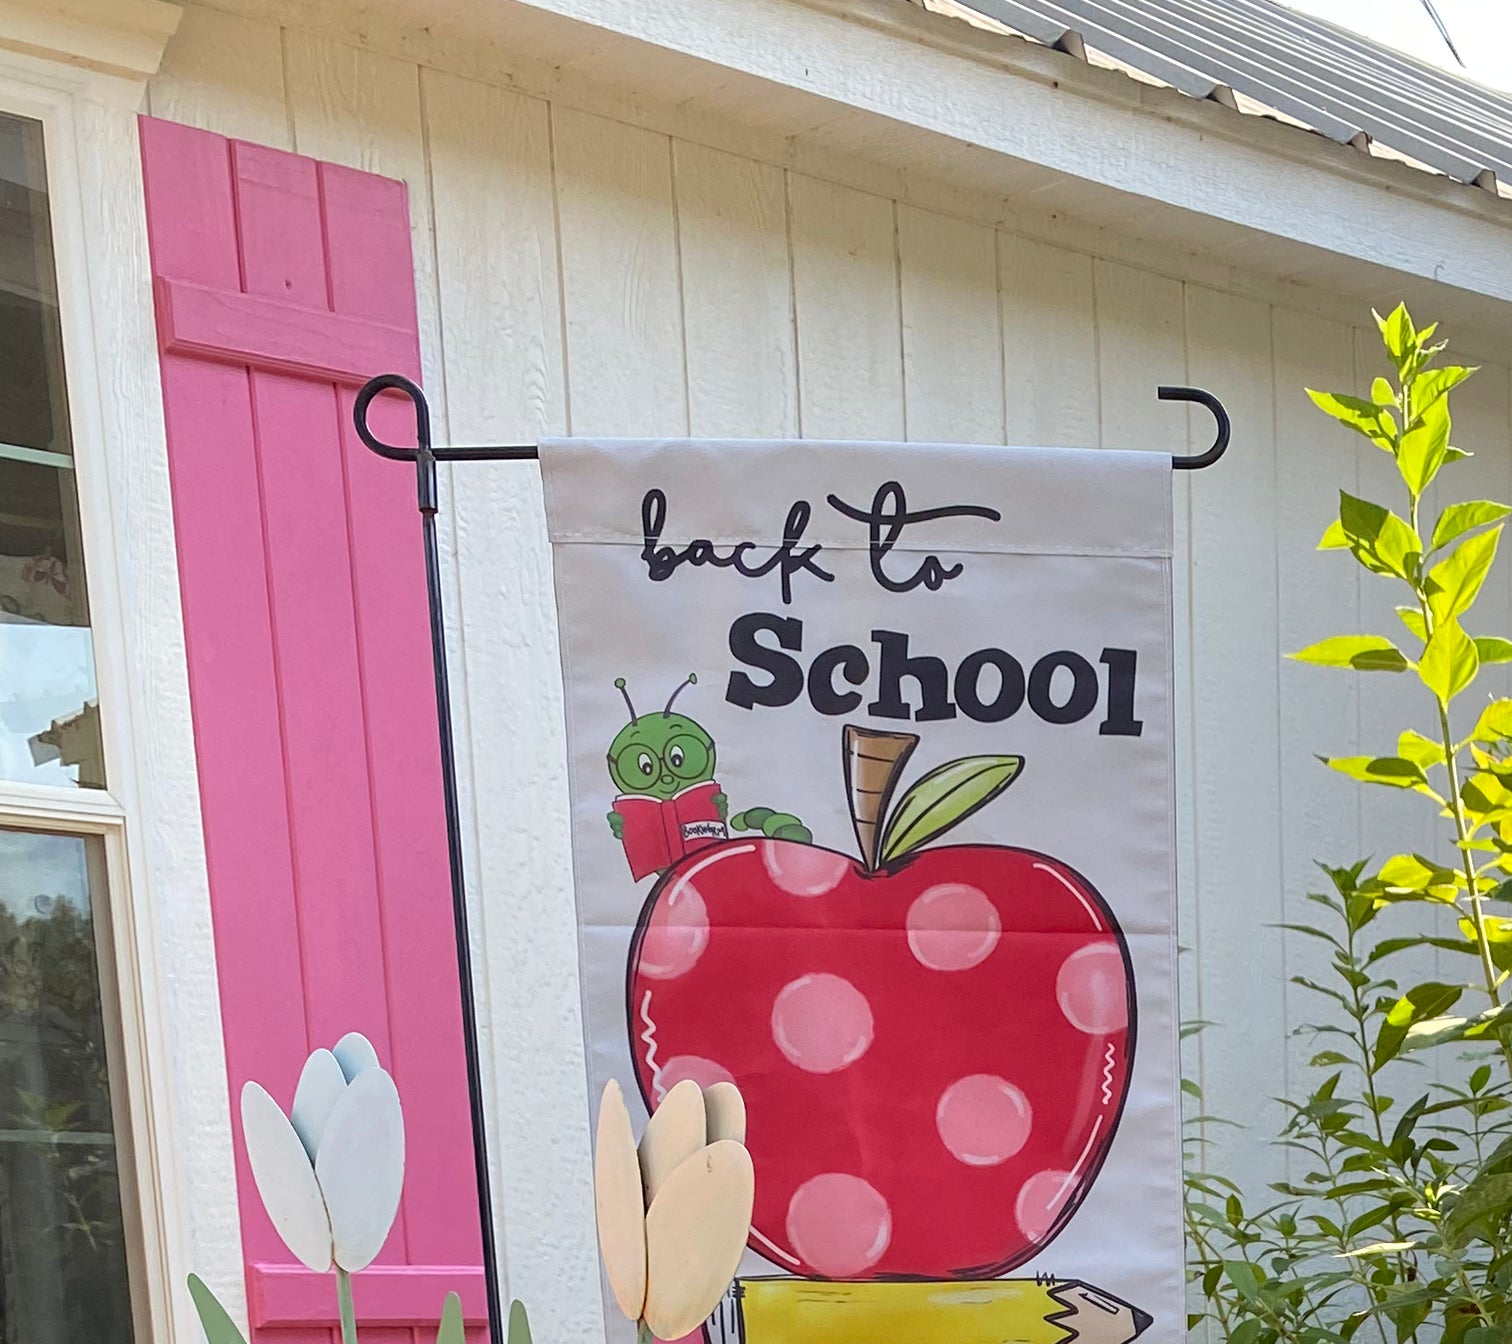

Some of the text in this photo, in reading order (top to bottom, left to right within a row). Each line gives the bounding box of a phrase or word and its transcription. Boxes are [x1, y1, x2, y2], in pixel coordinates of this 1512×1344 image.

[641, 480, 1001, 605] back to
[724, 612, 1144, 737] School
